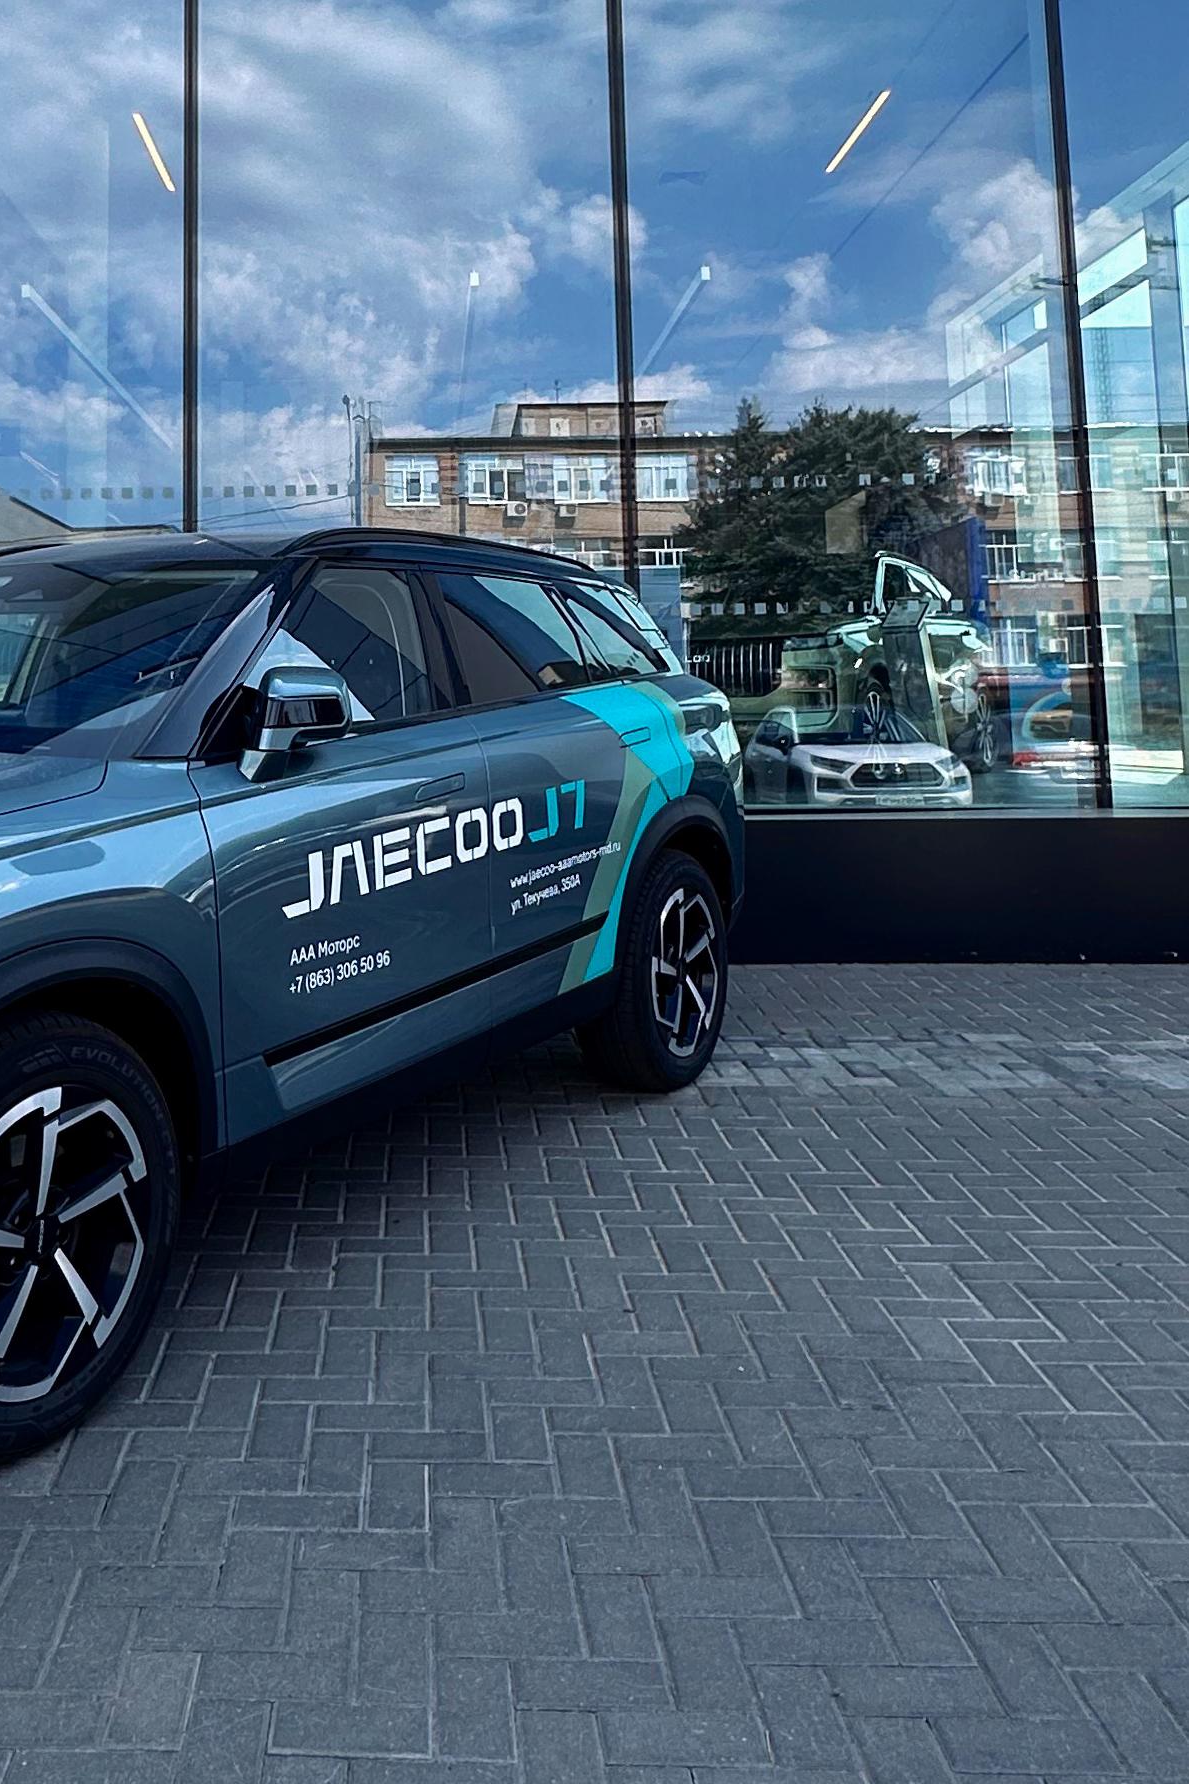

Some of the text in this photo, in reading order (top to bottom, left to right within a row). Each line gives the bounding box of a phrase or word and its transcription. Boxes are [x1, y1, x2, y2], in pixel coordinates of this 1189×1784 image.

[282, 779, 586, 919] JAECOO J7
[511, 899, 523, 916] ул.
[523, 884, 560, 906] Текучева,
[289, 950, 391, 994] +7 (863) 306 50 96
[290, 935, 361, 966] ААА Моторс
[70, 1046, 164, 1120] EVOLUTION
